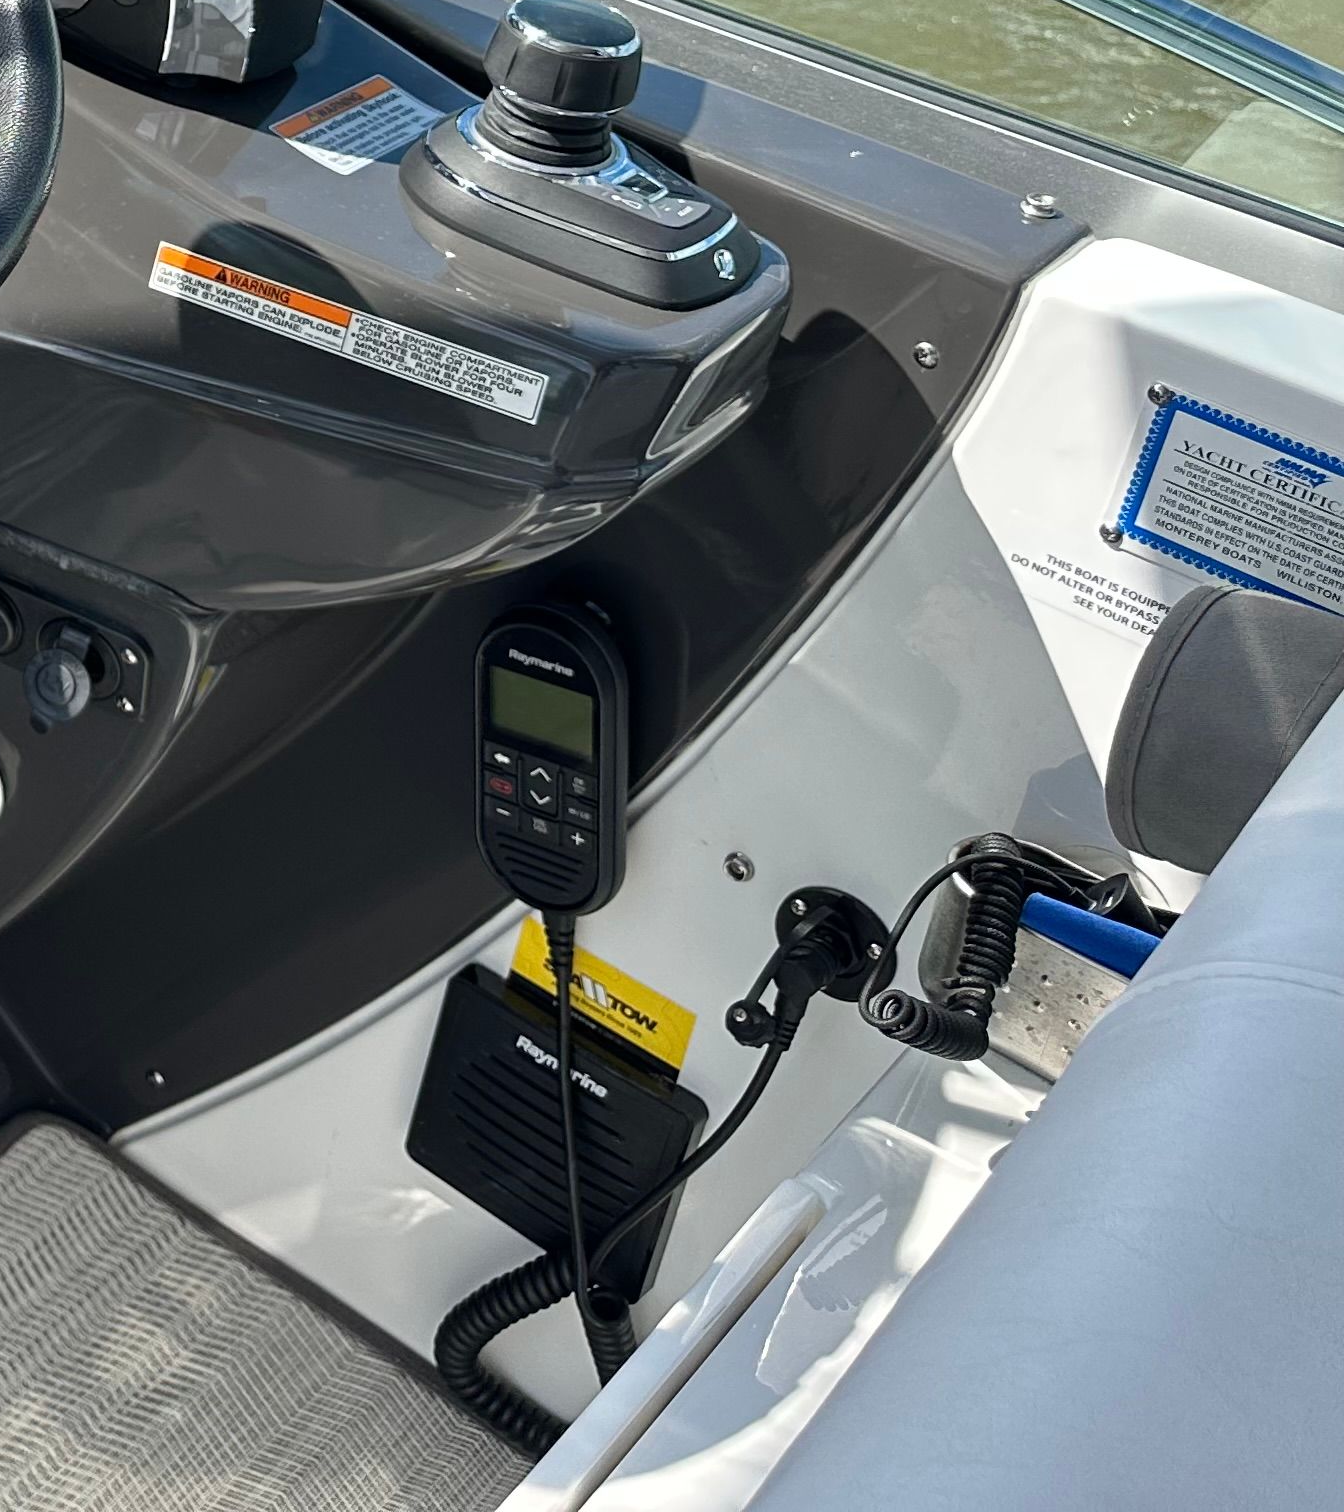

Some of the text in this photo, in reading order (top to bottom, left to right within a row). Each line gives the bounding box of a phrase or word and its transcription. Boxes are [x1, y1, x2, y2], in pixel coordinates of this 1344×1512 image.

[156, 274, 199, 296] BEFORE
[201, 290, 255, 316] STARTING
[158, 266, 214, 292] GASOLINE
[215, 286, 260, 309] VAPORS
[261, 303, 286, 320] CAN
[229, 271, 291, 305] WARNING
[351, 346, 394, 367] BELOW
[395, 361, 453, 389] CRUISING
[358, 326, 382, 340] FOR
[385, 335, 444, 364] GASOLINE
[445, 356, 463, 367] OR
[402, 333, 447, 354] ENGINE
[449, 349, 542, 386] COMPARTMENT
[410, 351, 460, 375] BLOWER
[461, 370, 487, 385] FOR
[489, 379, 524, 397] FOUR
[414, 362, 441, 377] RUN
[442, 371, 493, 394] BLOWER
[1182, 439, 1248, 473] YACHT
[1173, 465, 1278, 514] ON DATE OF CERTIFICATION
[1184, 460, 1276, 503] DESIGN COMPLIANCE WITH
[1166, 486, 1325, 557] NATIONAL MARINE MANUFACTURERS
[1188, 481, 1330, 545] RESPONSIBLE FOR PRODUCTION
[1154, 505, 1316, 579] STANDARDS EFFECT ON THE DATE OF
[1155, 518, 1221, 551] MONTEREY
[1221, 546, 1262, 570] BOATS
[1159, 494, 1177, 508] THIS
[1177, 502, 1201, 519] BOAT
[1201, 512, 1244, 536] COMPLIES
[1245, 530, 1267, 546] WITH
[1313, 559, 1344, 579] GUARD
[1011, 553, 1161, 625] DO NOT ALTER OR BYPASS
[1046, 553, 1120, 593] THIS BOAT IS
[1073, 594, 1130, 626] SEE YOUR
[508, 648, 575, 678] Raymarine
[516, 1034, 609, 1098] Raymrine
